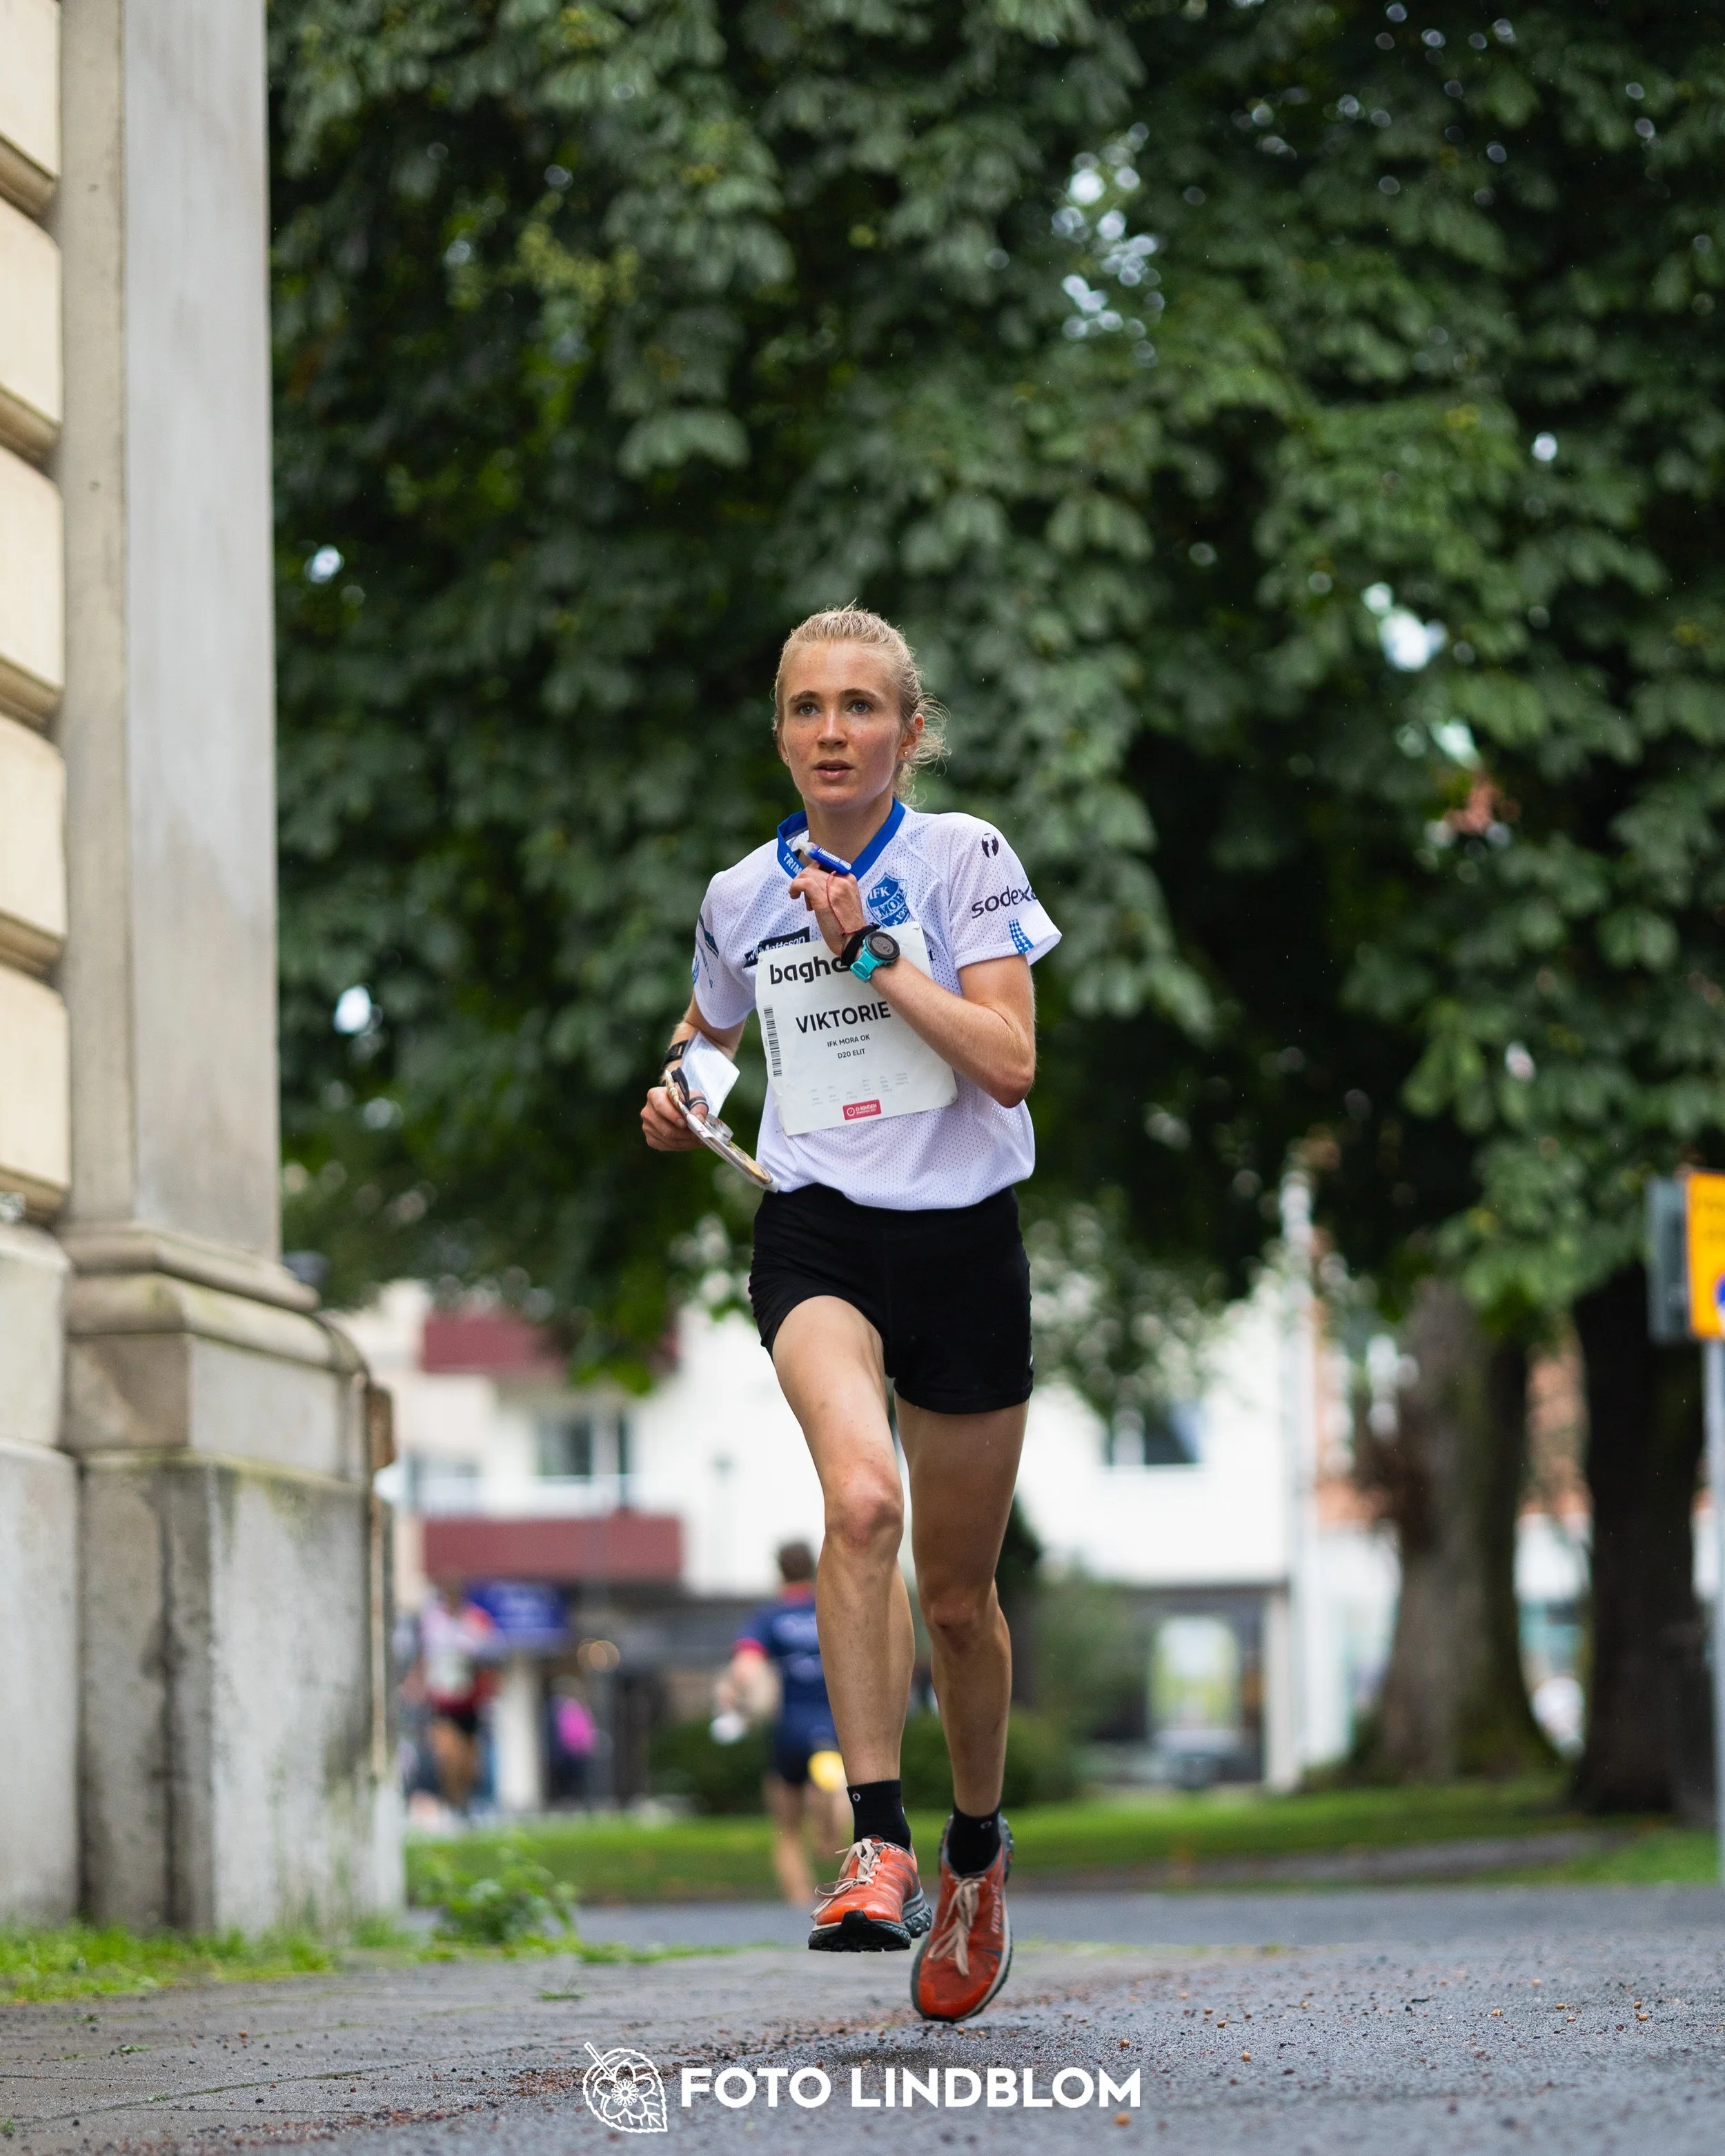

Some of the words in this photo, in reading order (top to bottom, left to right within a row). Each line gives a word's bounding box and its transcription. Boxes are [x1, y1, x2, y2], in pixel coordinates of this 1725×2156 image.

[784, 853, 802, 873] TRIM
[869, 887, 890, 900] IFK
[796, 1001, 891, 1033] VIKTORIE
[827, 1039, 838, 1047] IFK
[839, 1036, 859, 1045] MORA
